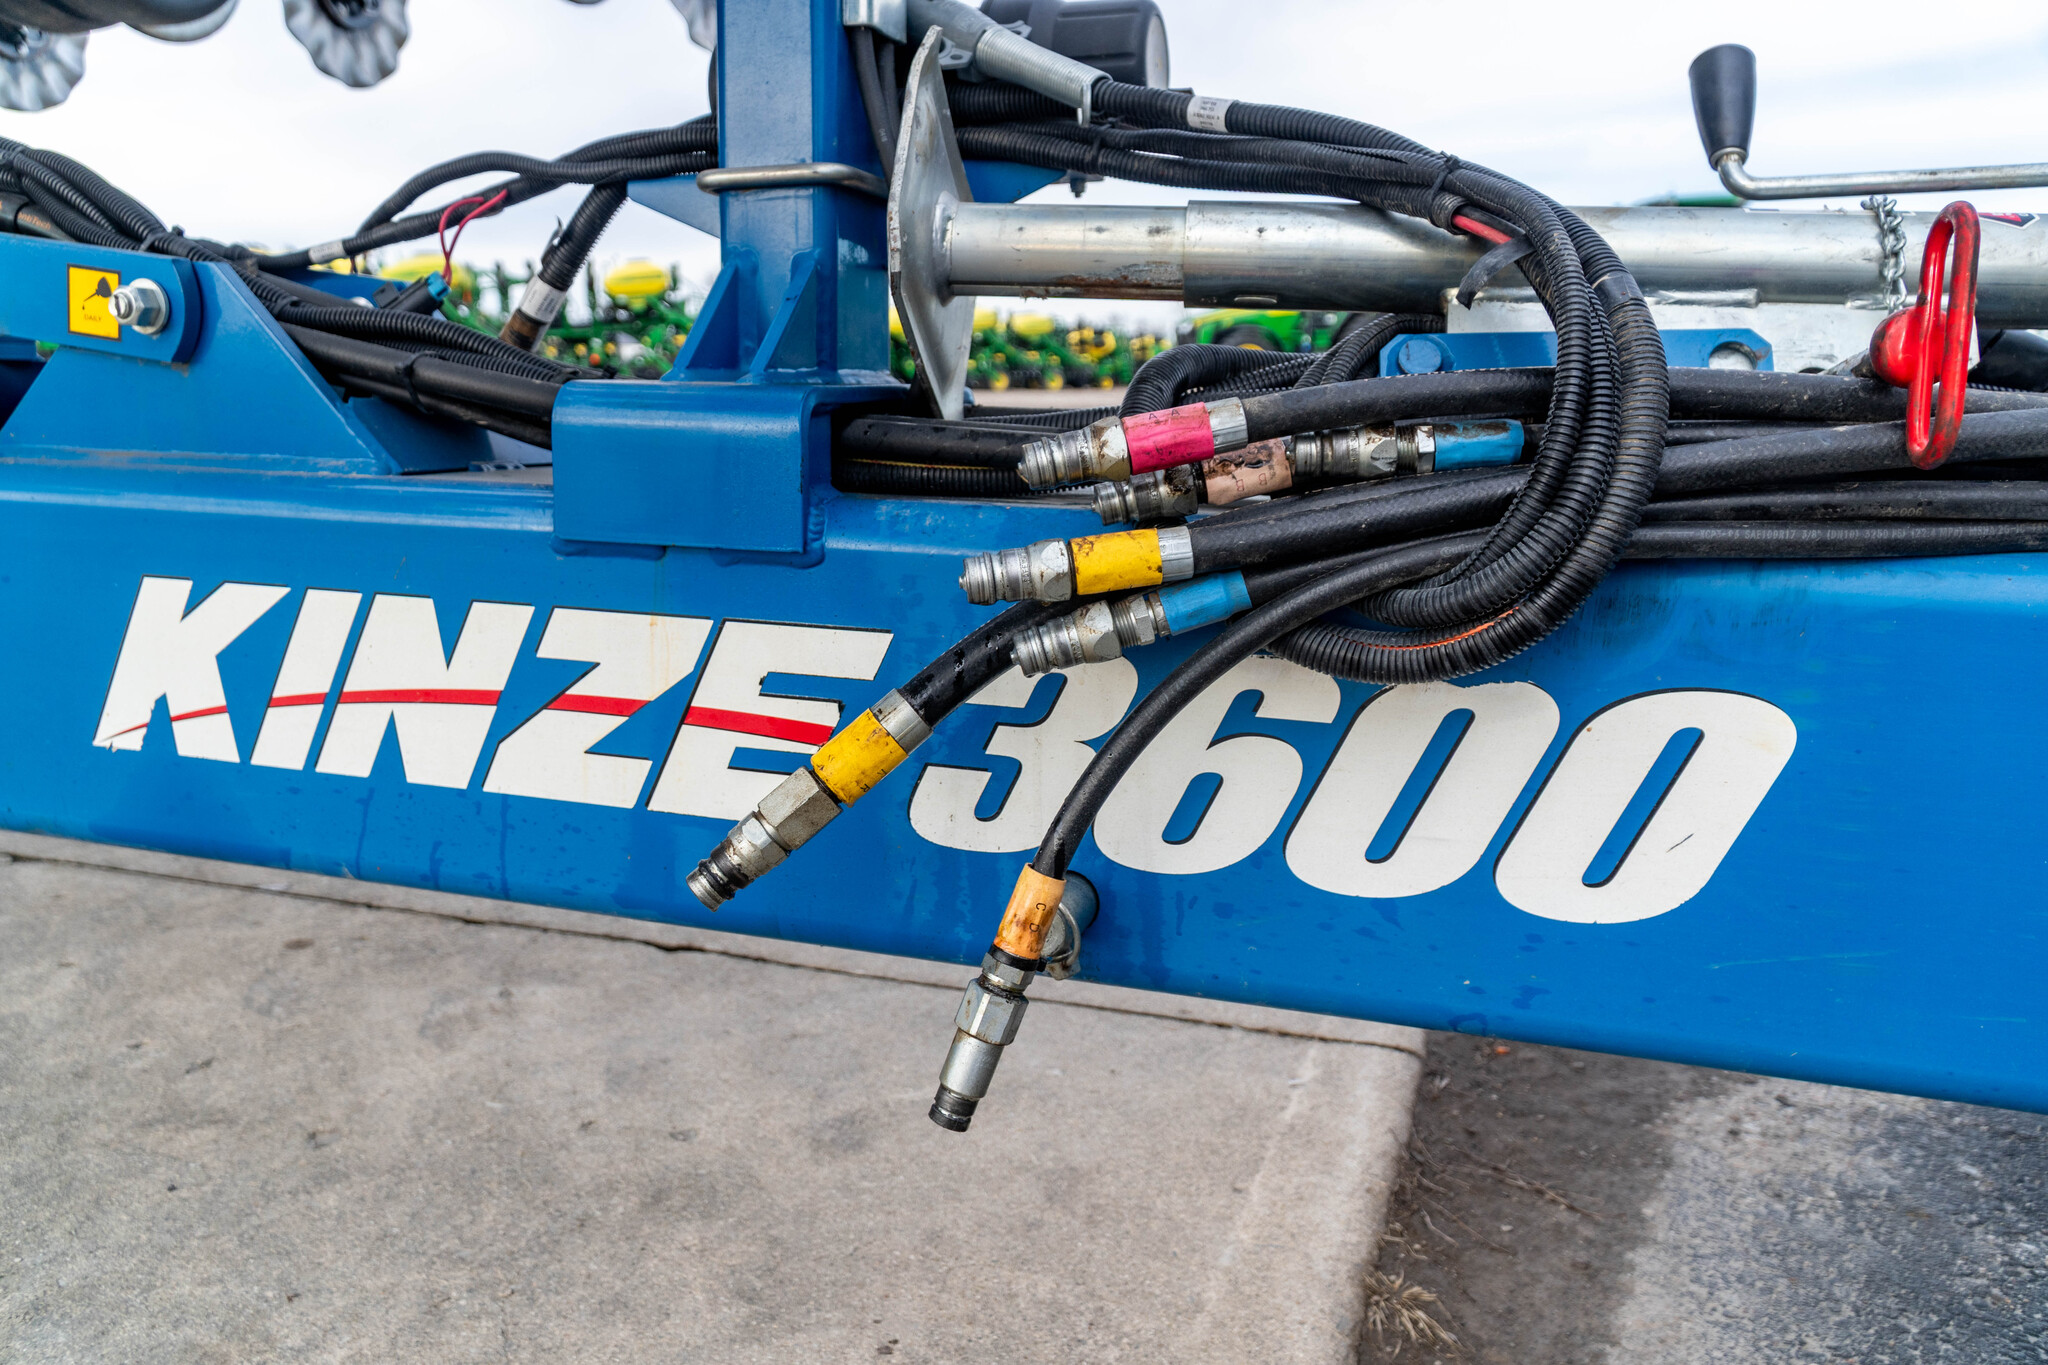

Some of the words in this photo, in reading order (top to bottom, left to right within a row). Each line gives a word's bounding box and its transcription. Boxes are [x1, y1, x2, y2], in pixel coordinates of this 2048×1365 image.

[1148, 412, 1158, 421] A
[1171, 409, 1180, 417] A
[93, 573, 894, 822] KINZE
[908, 655, 1799, 925] 3600
[1035, 902, 1047, 912] C
